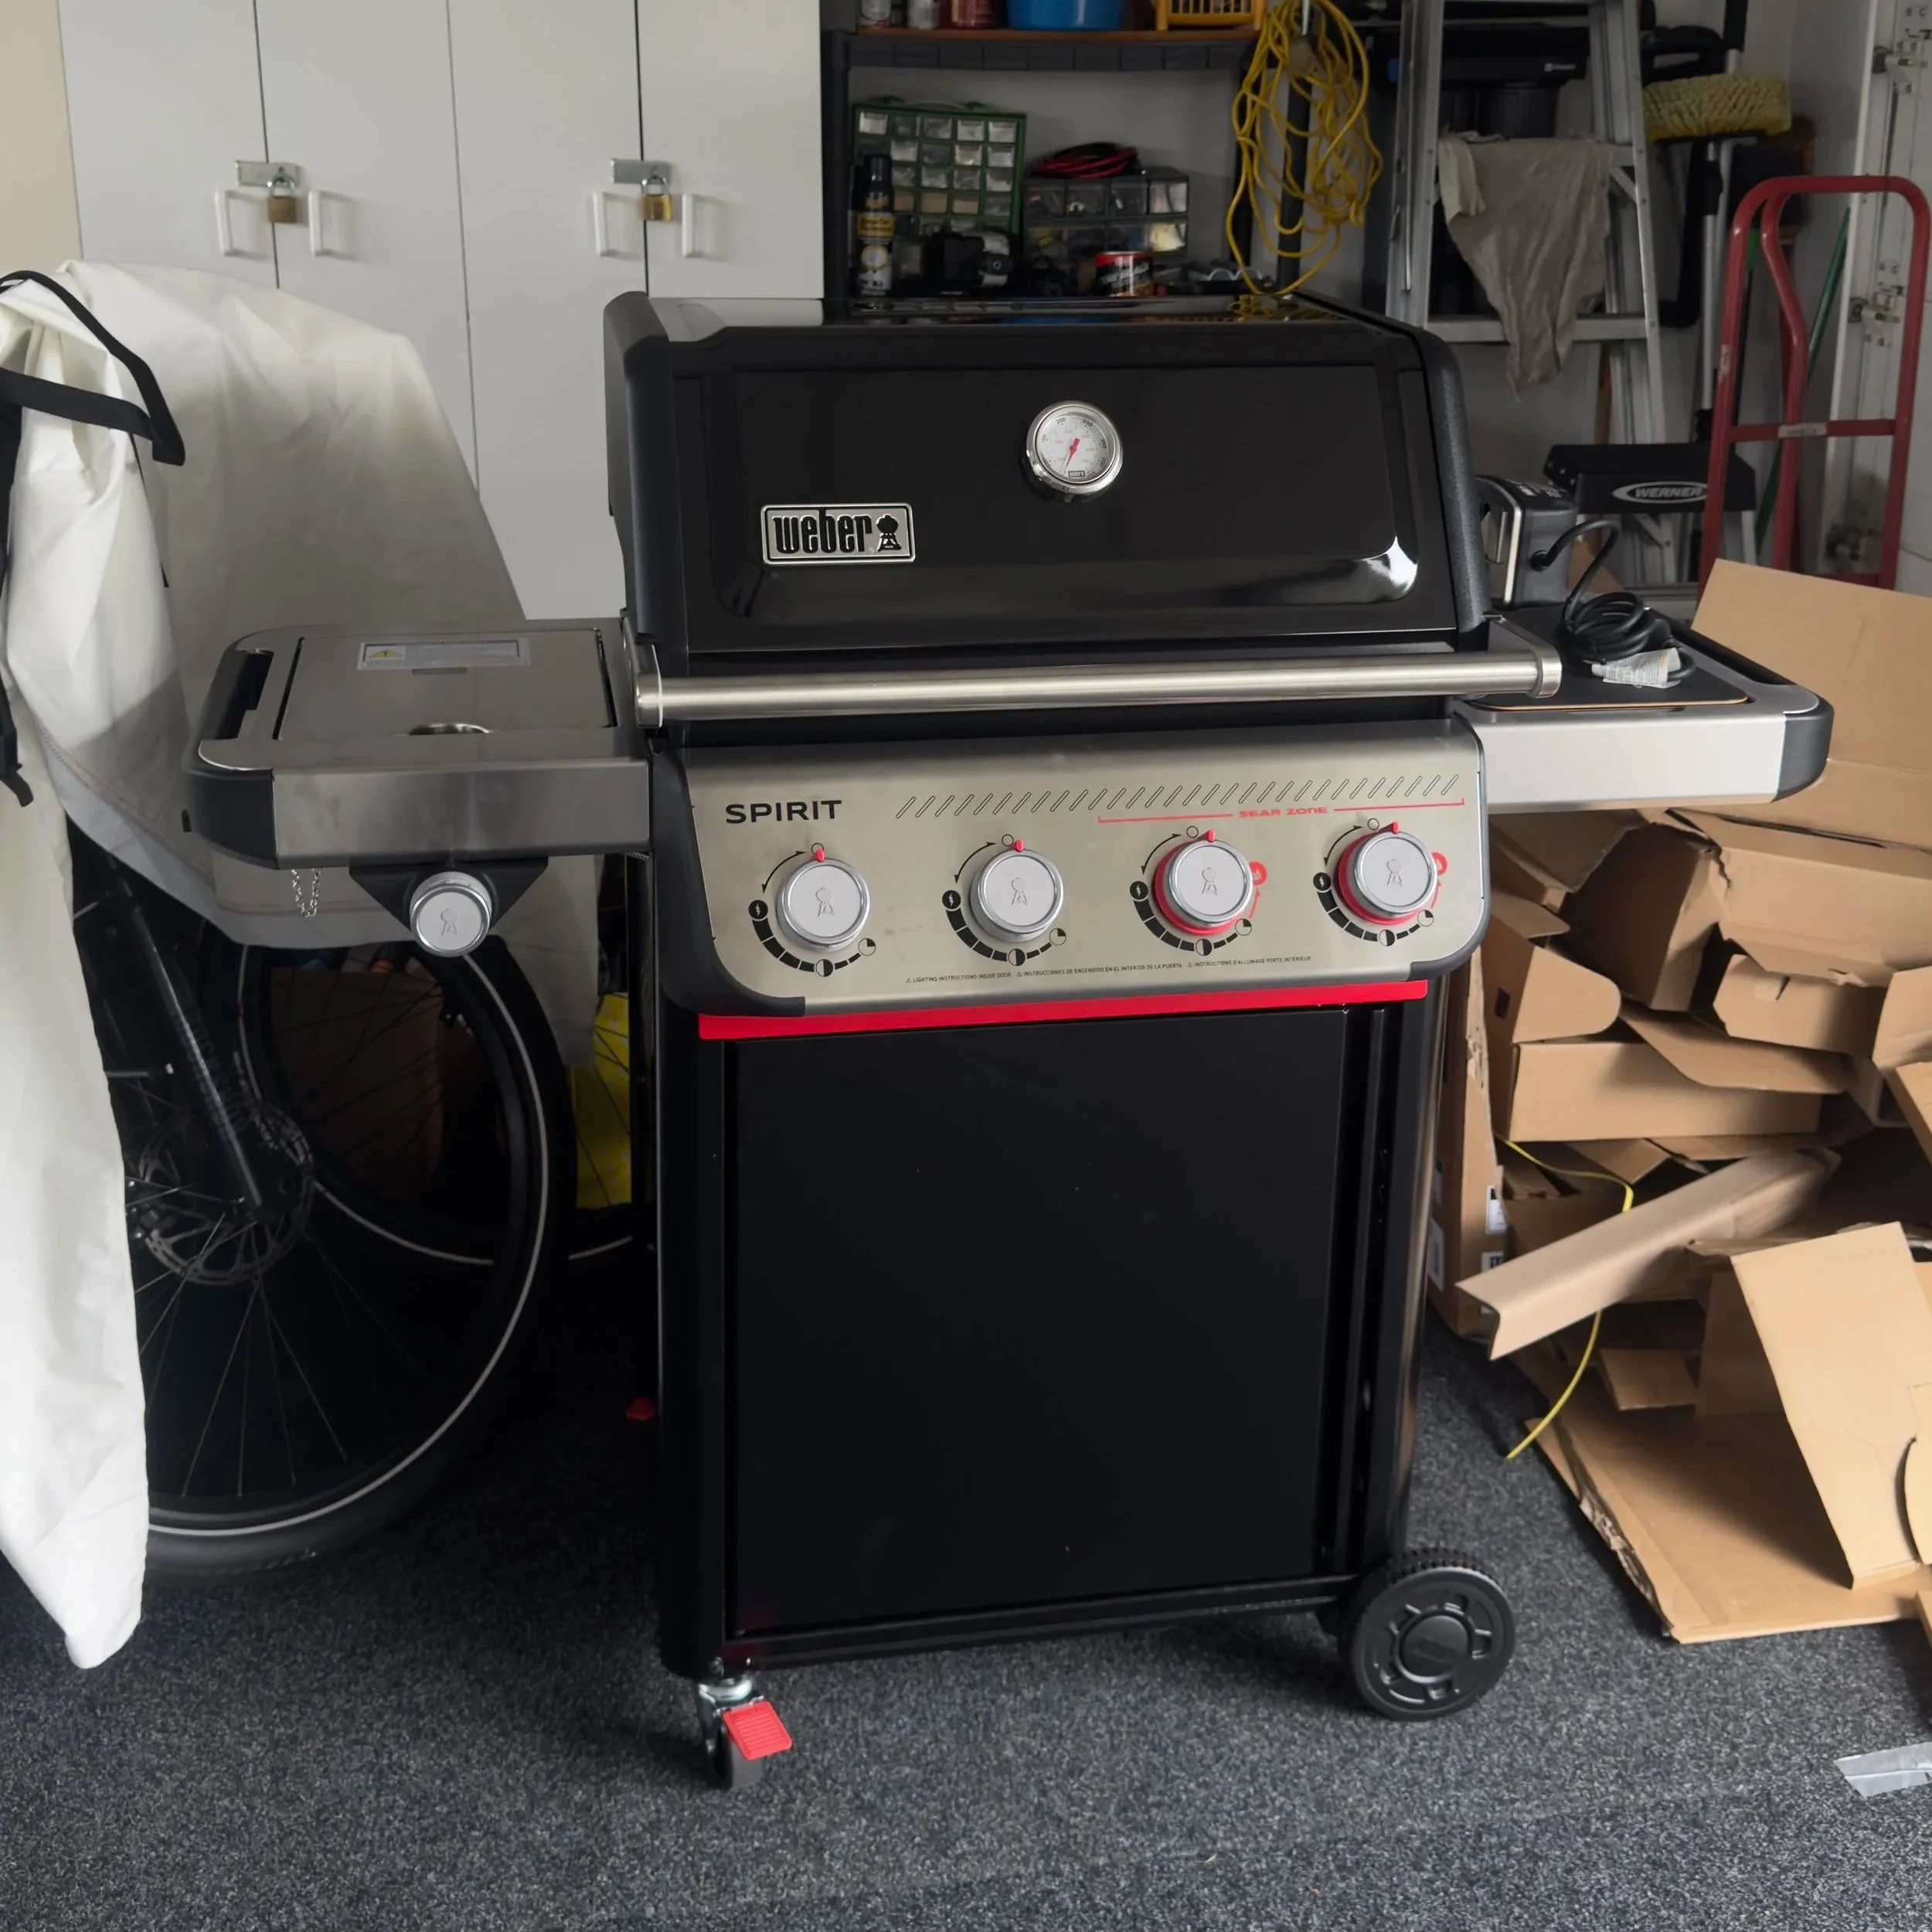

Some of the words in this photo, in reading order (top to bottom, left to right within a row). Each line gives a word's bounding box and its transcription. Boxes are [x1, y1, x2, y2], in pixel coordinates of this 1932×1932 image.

[1635, 487, 1702, 498] WERNER
[773, 508, 872, 553] weber
[725, 800, 842, 824] SPIRIT
[1239, 809, 1281, 818] SEAR
[1286, 807, 1327, 815] ZONE
